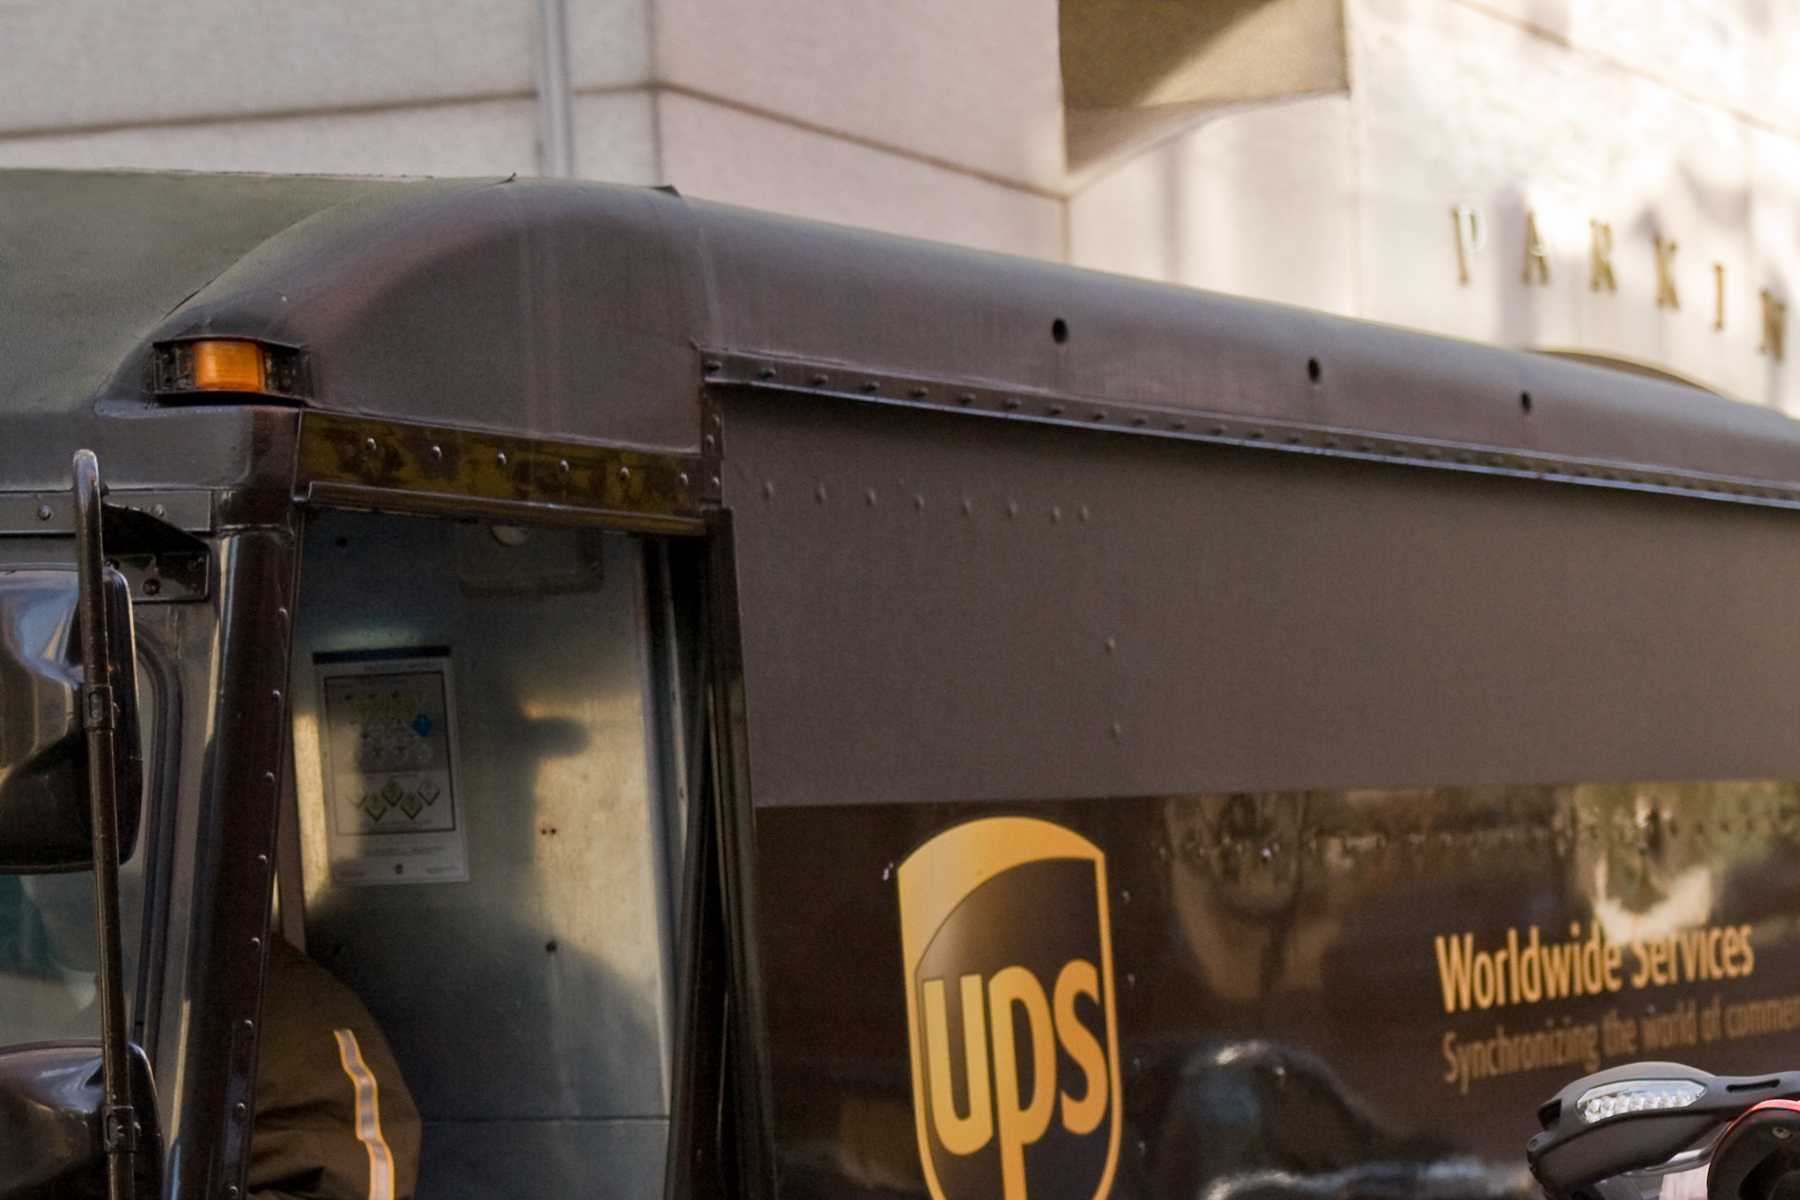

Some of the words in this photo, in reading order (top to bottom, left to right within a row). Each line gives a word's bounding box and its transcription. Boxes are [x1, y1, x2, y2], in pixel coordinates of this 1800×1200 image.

[1434, 922, 1621, 1013] Worldwide
[1629, 921, 1756, 990] Services
[1441, 1018, 1600, 1093] Synchronizing
[1603, 1009, 1638, 1057] the
[1641, 999, 1698, 1051] world
[1701, 991, 1722, 1041] of
